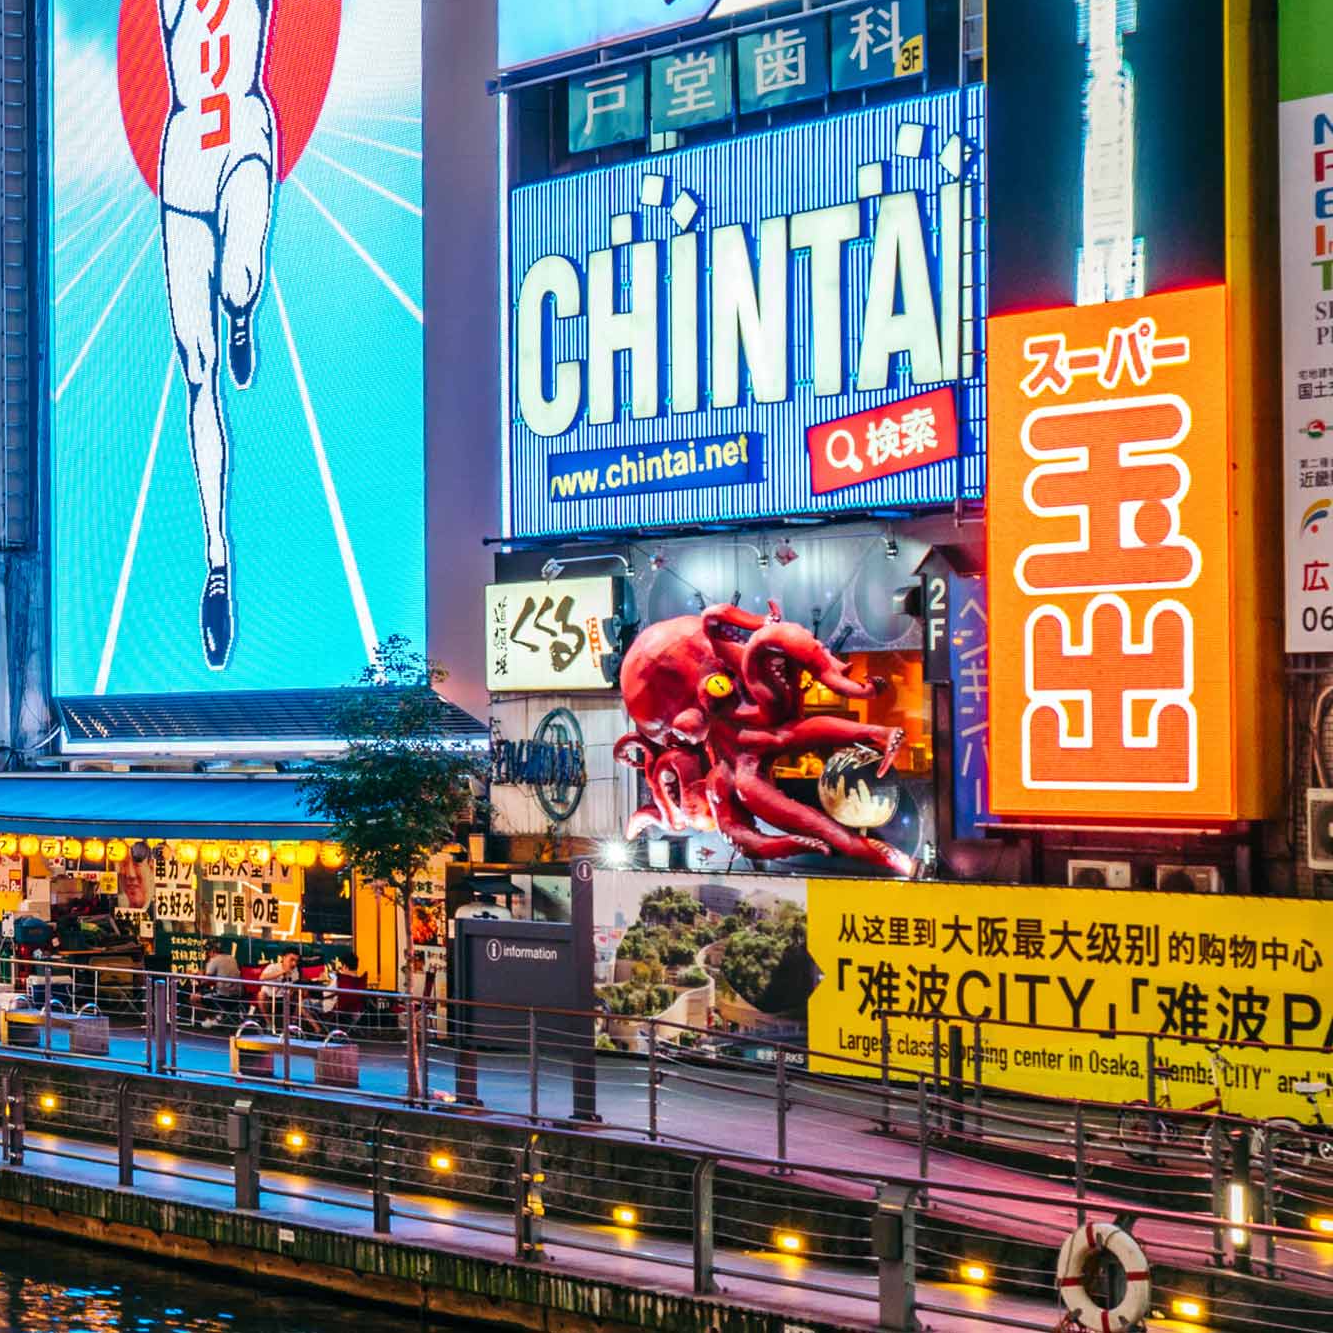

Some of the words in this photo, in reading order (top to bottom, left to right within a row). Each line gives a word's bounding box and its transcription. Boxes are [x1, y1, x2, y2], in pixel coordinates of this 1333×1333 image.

[901, 45, 921, 72] 3F
[1020, 316, 1192, 399] スーパー
[865, 407, 938, 467] 検索
[1014, 393, 1203, 793] 玉出
[156, 890, 196, 917] お好み
[214, 893, 280, 924] 兄貴の店
[502, 942, 559, 962] information
[1013, 1048, 1065, 1072] center
[1068, 1048, 1085, 1073] in
